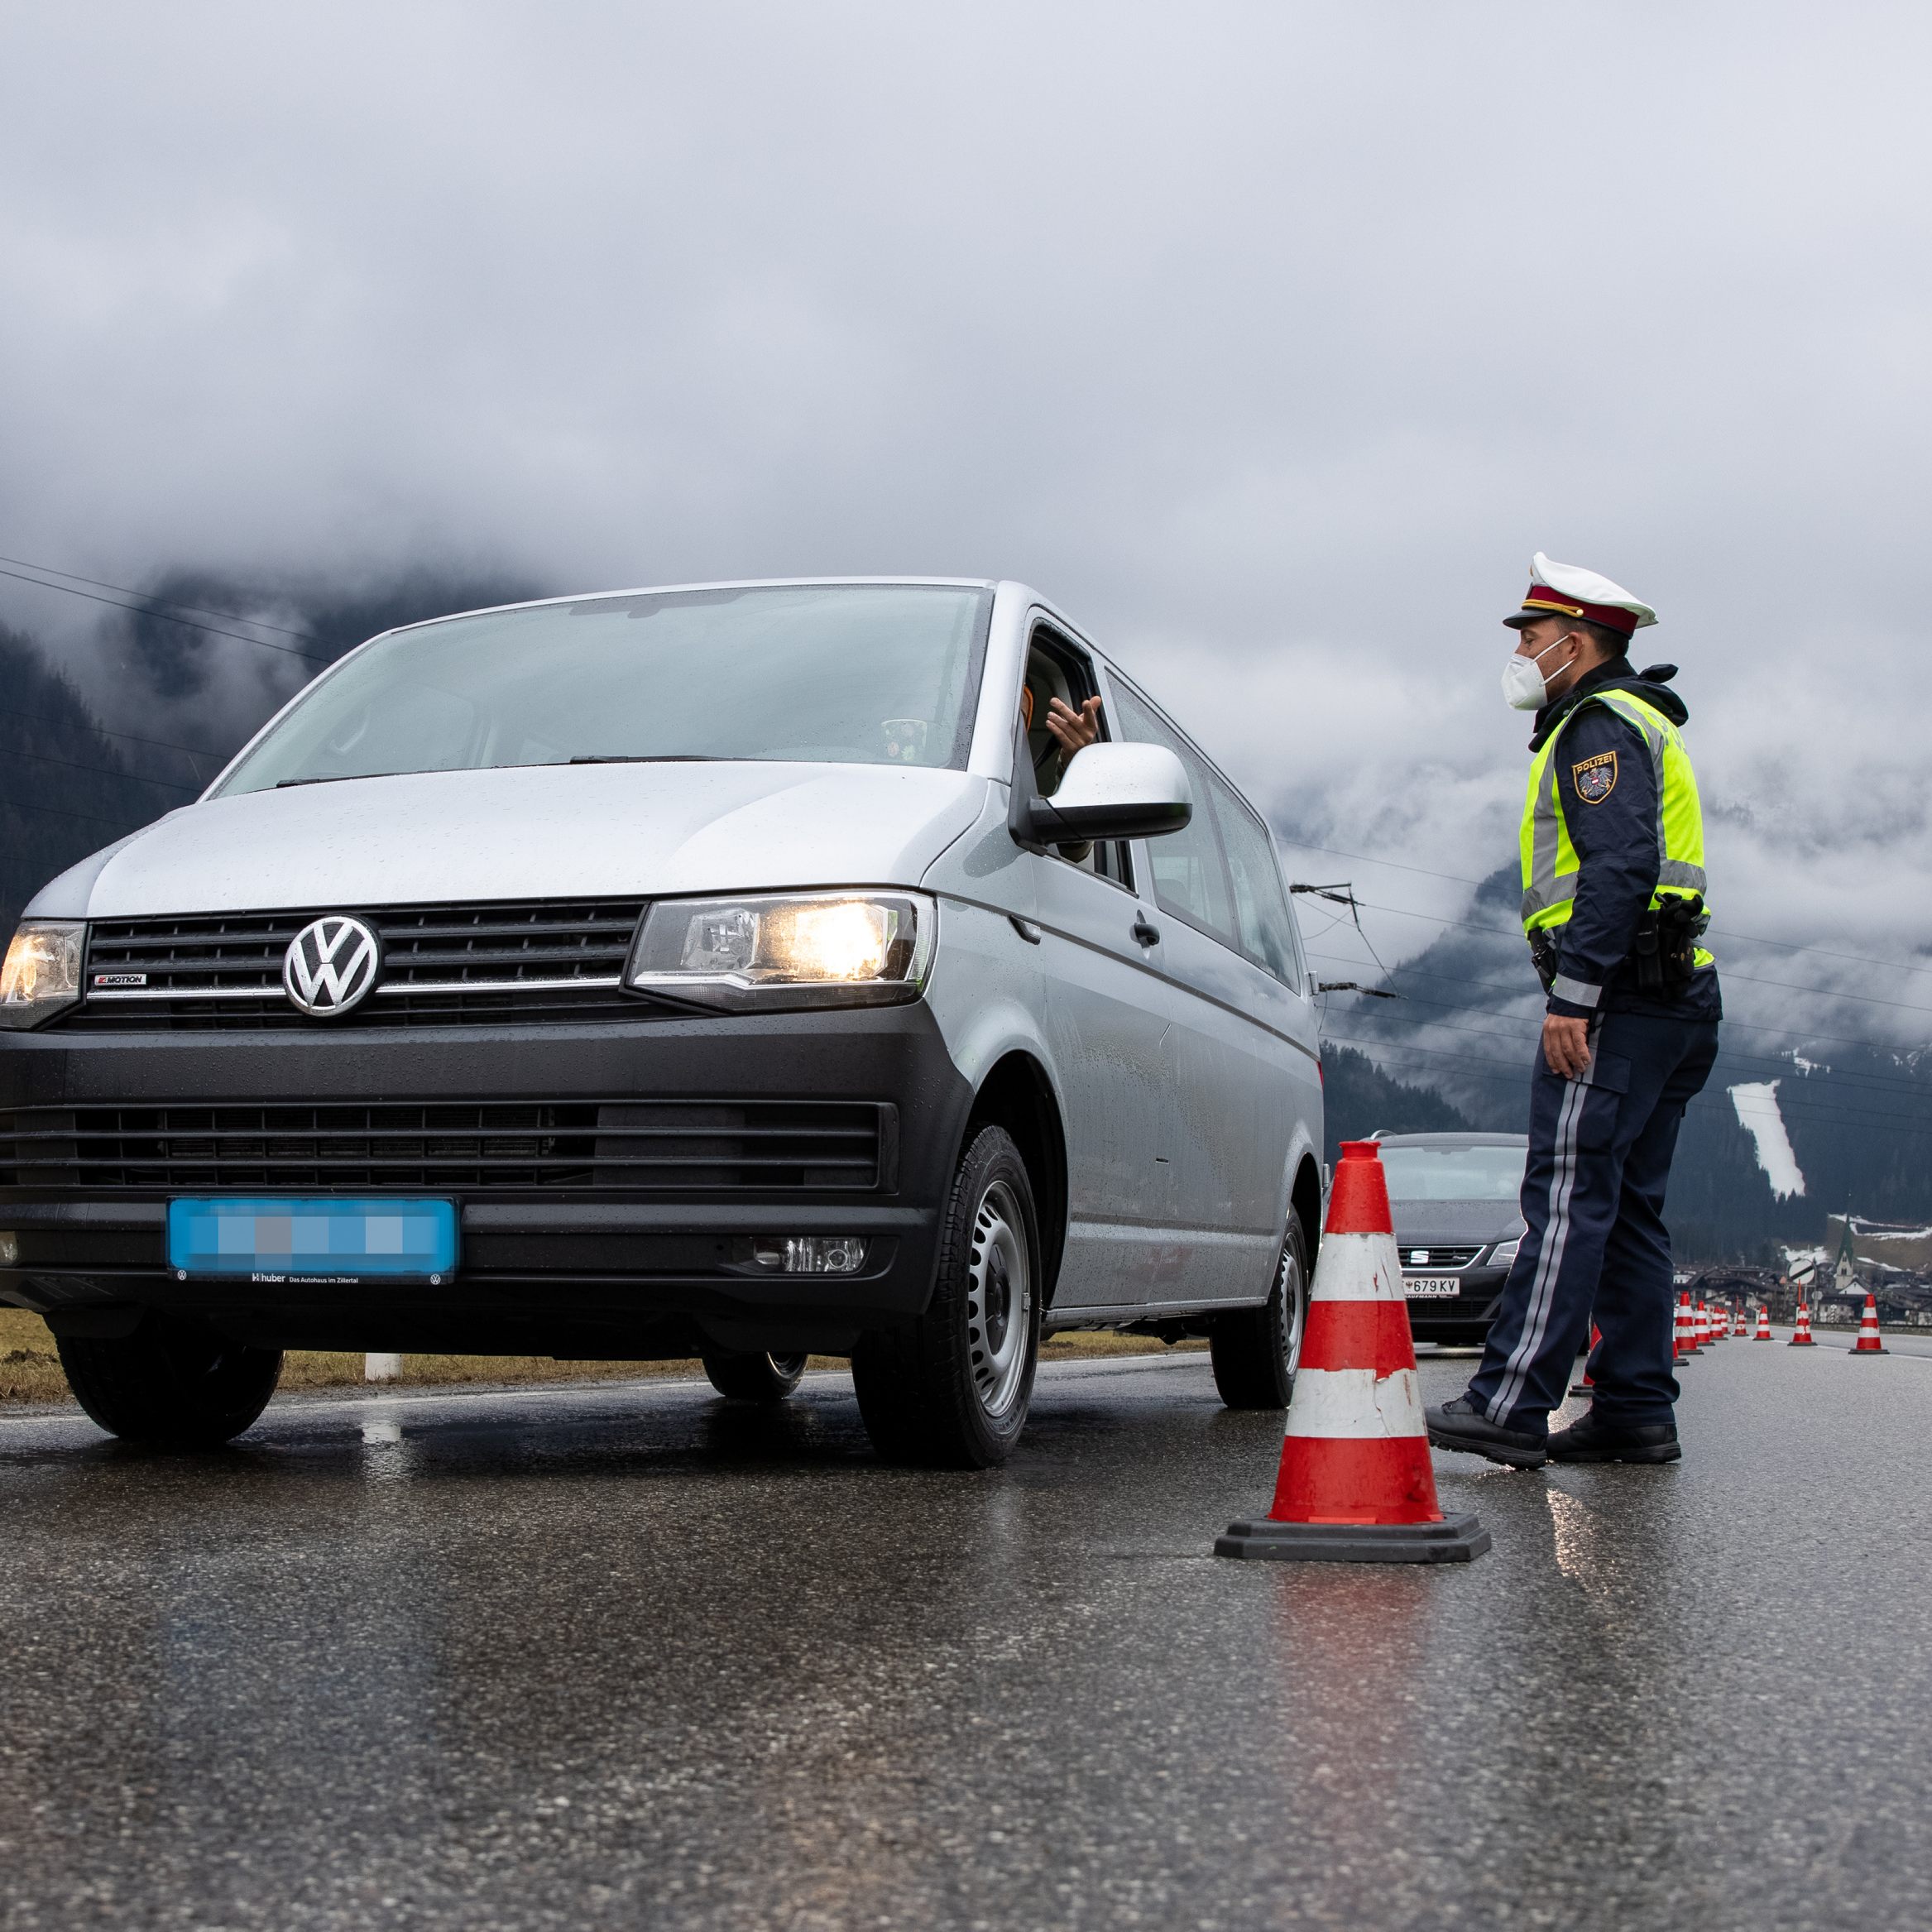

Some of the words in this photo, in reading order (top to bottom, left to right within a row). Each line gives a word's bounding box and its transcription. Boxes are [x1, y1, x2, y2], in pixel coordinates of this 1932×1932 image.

[1576, 755, 1613, 774] POLIZEI
[261, 1273, 285, 1282] huber
[1413, 1280, 1436, 1292] 679
[1440, 1280, 1455, 1292] KV
